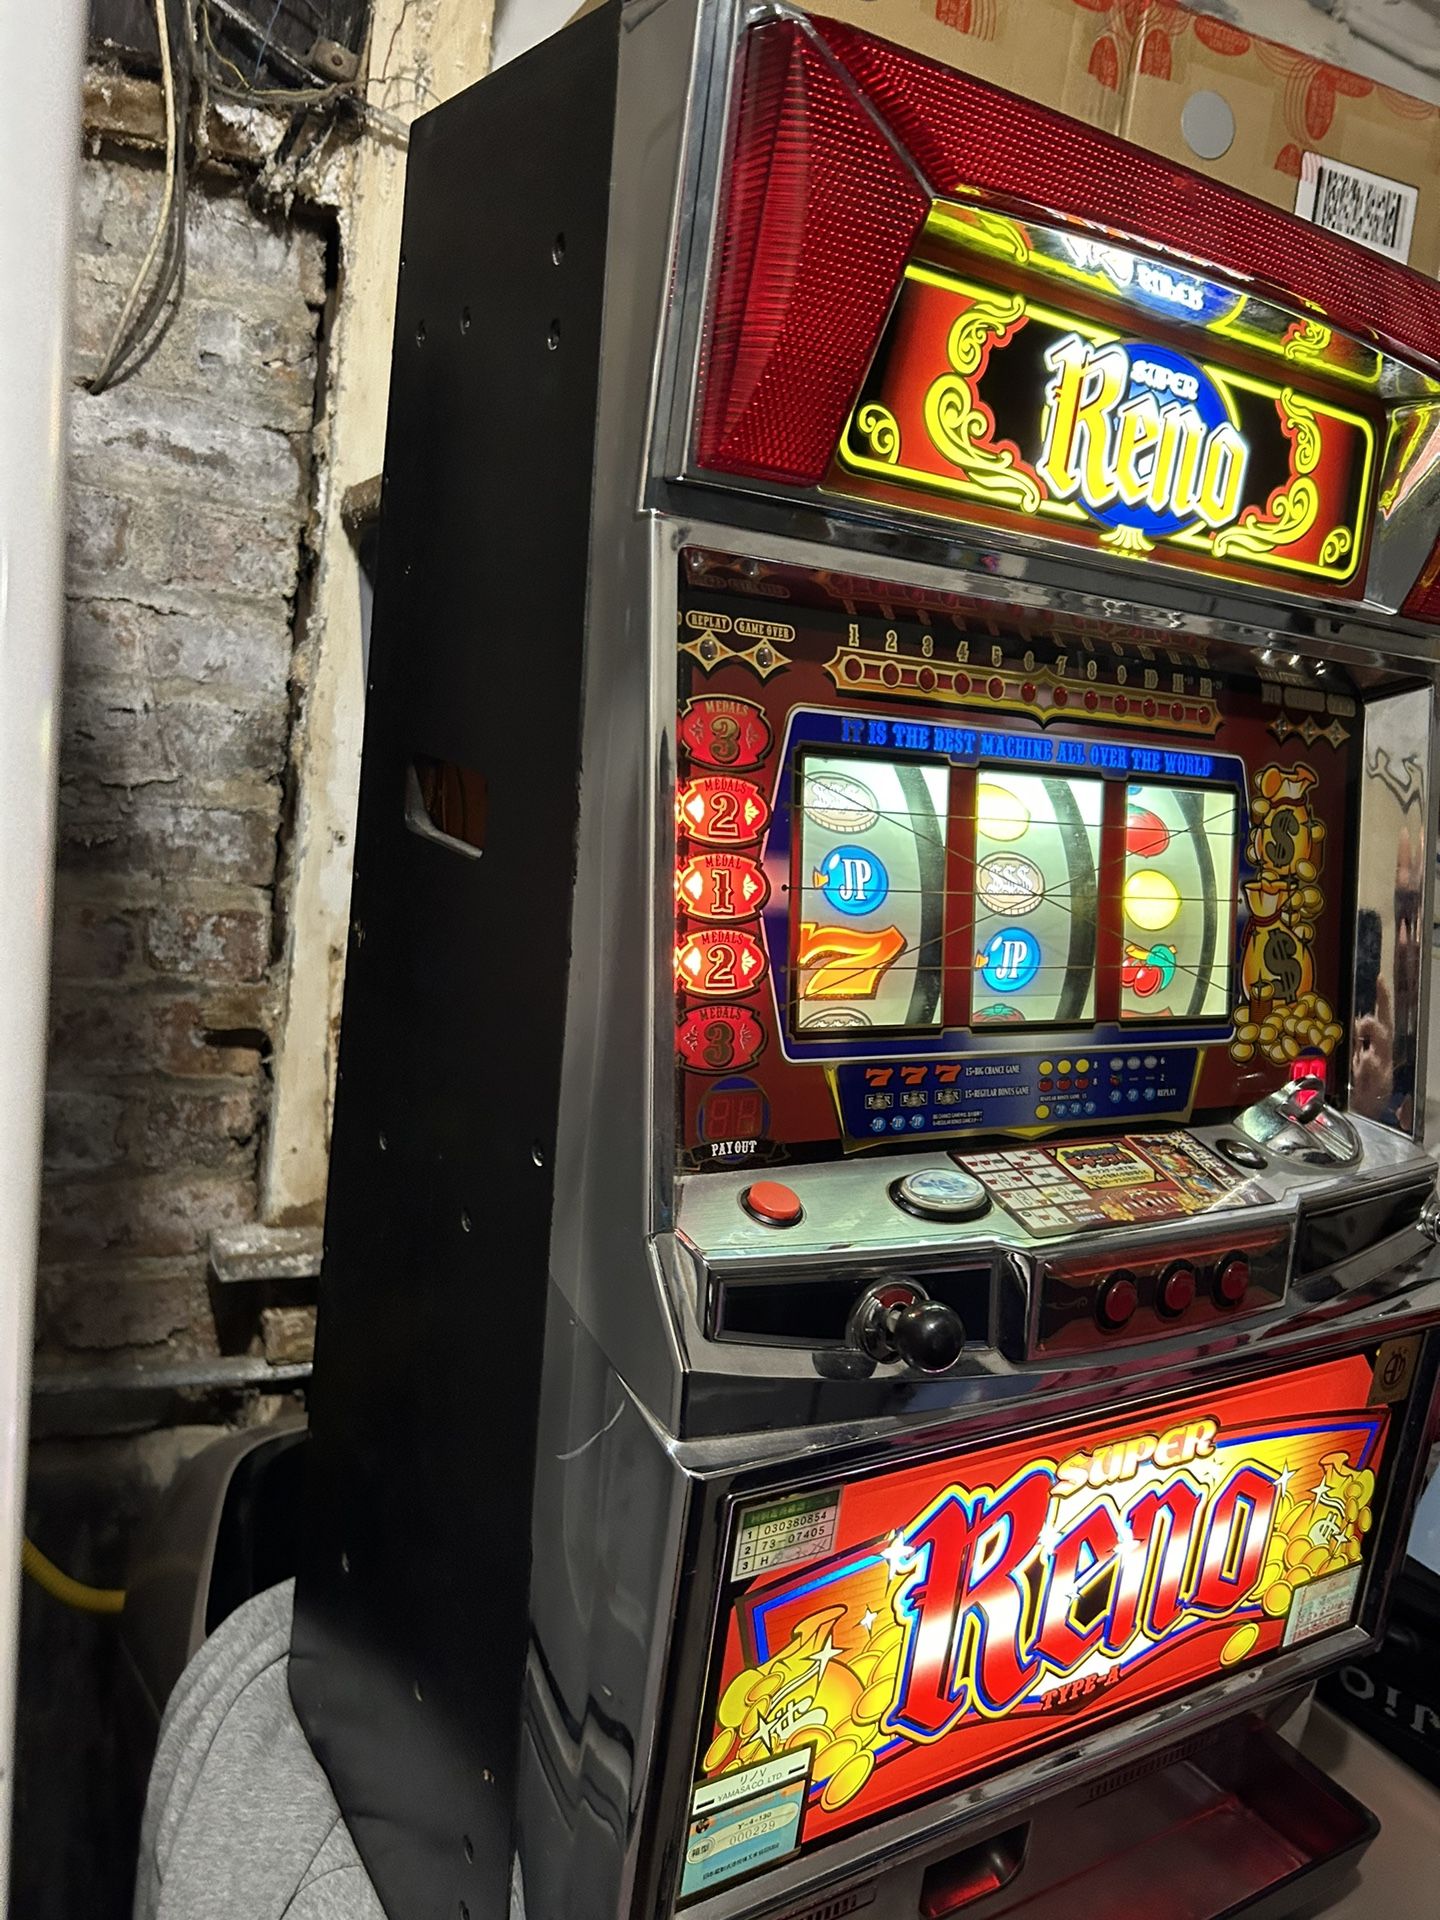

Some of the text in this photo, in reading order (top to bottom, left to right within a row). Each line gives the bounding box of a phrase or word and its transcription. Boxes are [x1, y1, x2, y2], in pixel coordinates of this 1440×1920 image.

[1130, 359, 1199, 401] SUPER
[1036, 334, 1248, 528] Reno
[691, 614, 728, 630] REPLAY
[739, 621, 790, 639] GAME OVER
[849, 624, 1212, 697] 1 2 3 4 5 6 7 8 9 10 11 12
[705, 701, 749, 717] MEDALS
[710, 715, 740, 764] 3
[841, 717, 1212, 777] IT IS THE BEST MACHINE ALL OVER THE WORLD
[704, 777, 748, 794] MEDALS
[708, 792, 739, 838] 2
[705, 855, 742, 869] MEDAL
[839, 857, 872, 901] JP
[711, 869, 735, 914] 1
[701, 931, 744, 945] MEDALS
[705, 944, 737, 988] 2
[995, 940, 1028, 979] JP
[700, 1007, 743, 1021] MEDALS
[703, 1021, 735, 1067] 3
[865, 1068, 894, 1087] 7
[900, 1066, 928, 1085] 7
[935, 1064, 962, 1083] 7
[1006, 1064, 1020, 1074] GAME
[1015, 1086, 1029, 1096] GAME
[1157, 1088, 1177, 1097] REPLAY
[711, 1140, 757, 1156] PAYOUT
[1051, 1416, 1220, 1498] SUPER
[764, 1511, 827, 1535] 030380854
[744, 1546, 751, 1555] 2
[742, 1561, 749, 1570] 3
[882, 1459, 1280, 1742] Reno
[1040, 1665, 1122, 1711] TYPE-A
[717, 1784, 751, 1802] YAMASA
[729, 1820, 776, 1845] 000229
